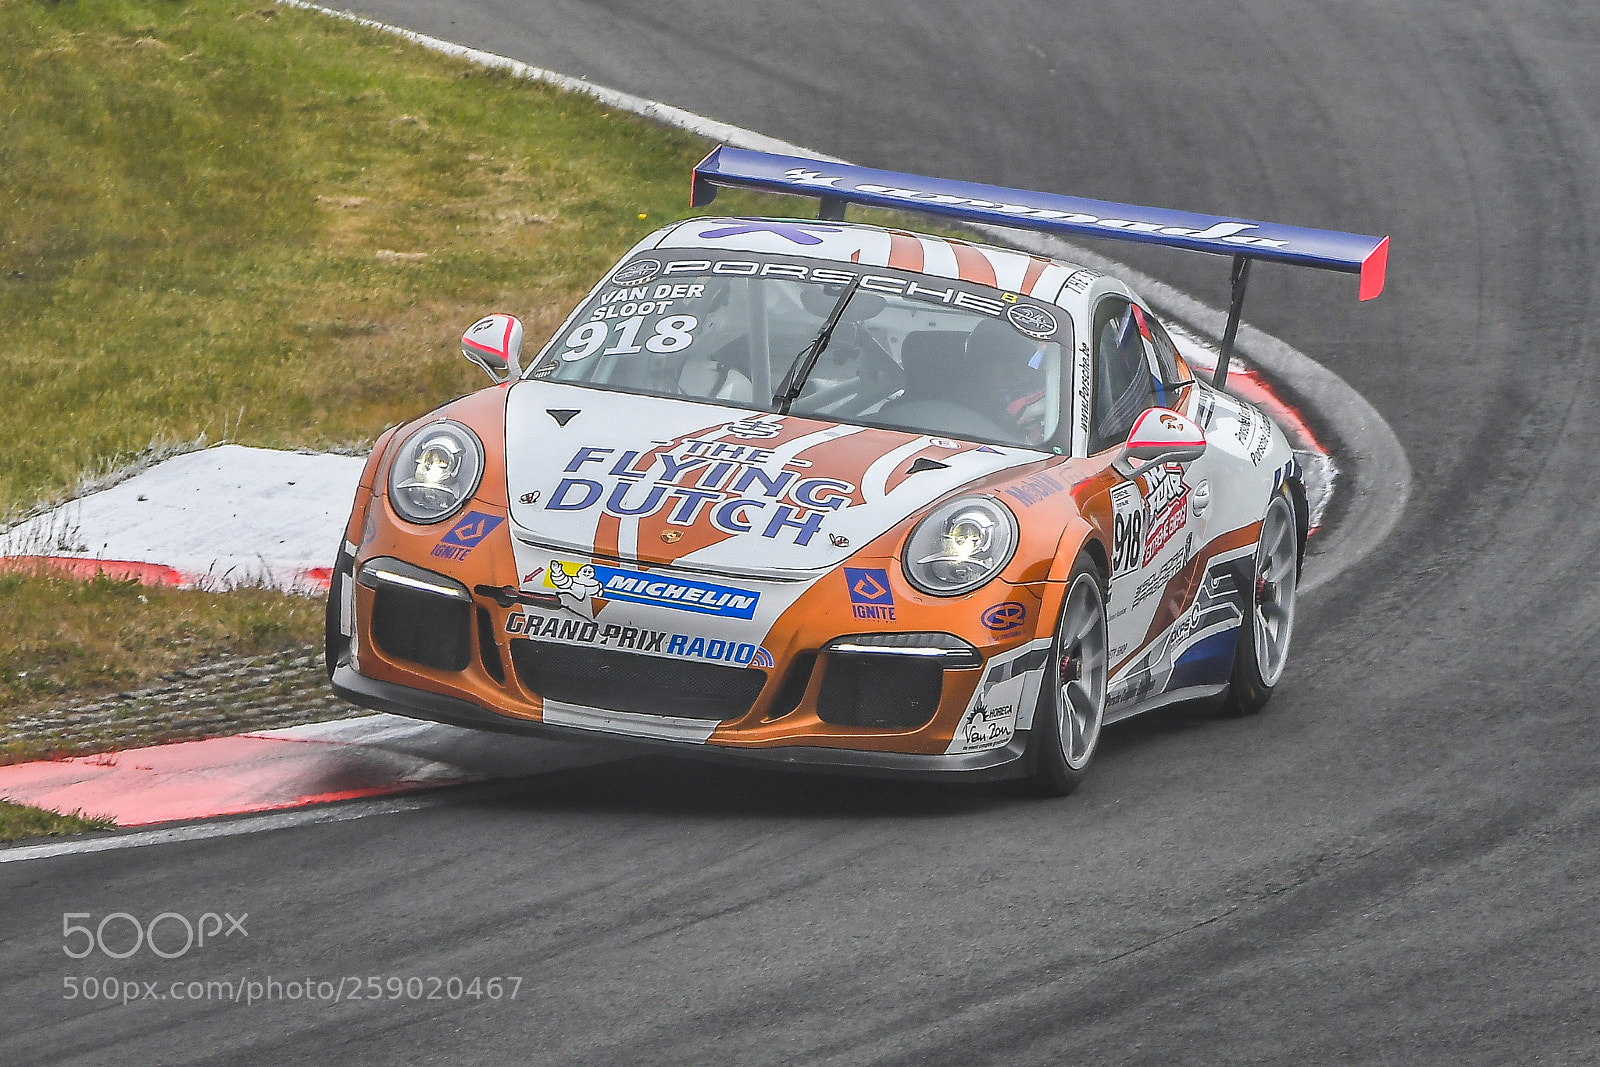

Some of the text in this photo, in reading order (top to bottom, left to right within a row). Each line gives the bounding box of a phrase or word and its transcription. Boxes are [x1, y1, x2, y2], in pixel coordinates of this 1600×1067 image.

[600, 284, 705, 306] VAN DER
[662, 260, 1005, 316] PORSCHE
[590, 300, 674, 322] SLOOT
[560, 314, 699, 363] 918
[686, 440, 776, 464] THE
[562, 446, 856, 512] FLYING
[544, 477, 826, 547] DUTCH
[430, 543, 472, 562] IGNITE
[1113, 508, 1141, 571] 918
[605, 574, 757, 611] MICHELIN
[852, 605, 897, 621] IGNITE
[505, 611, 757, 665] GRAND PRIX RADIO
